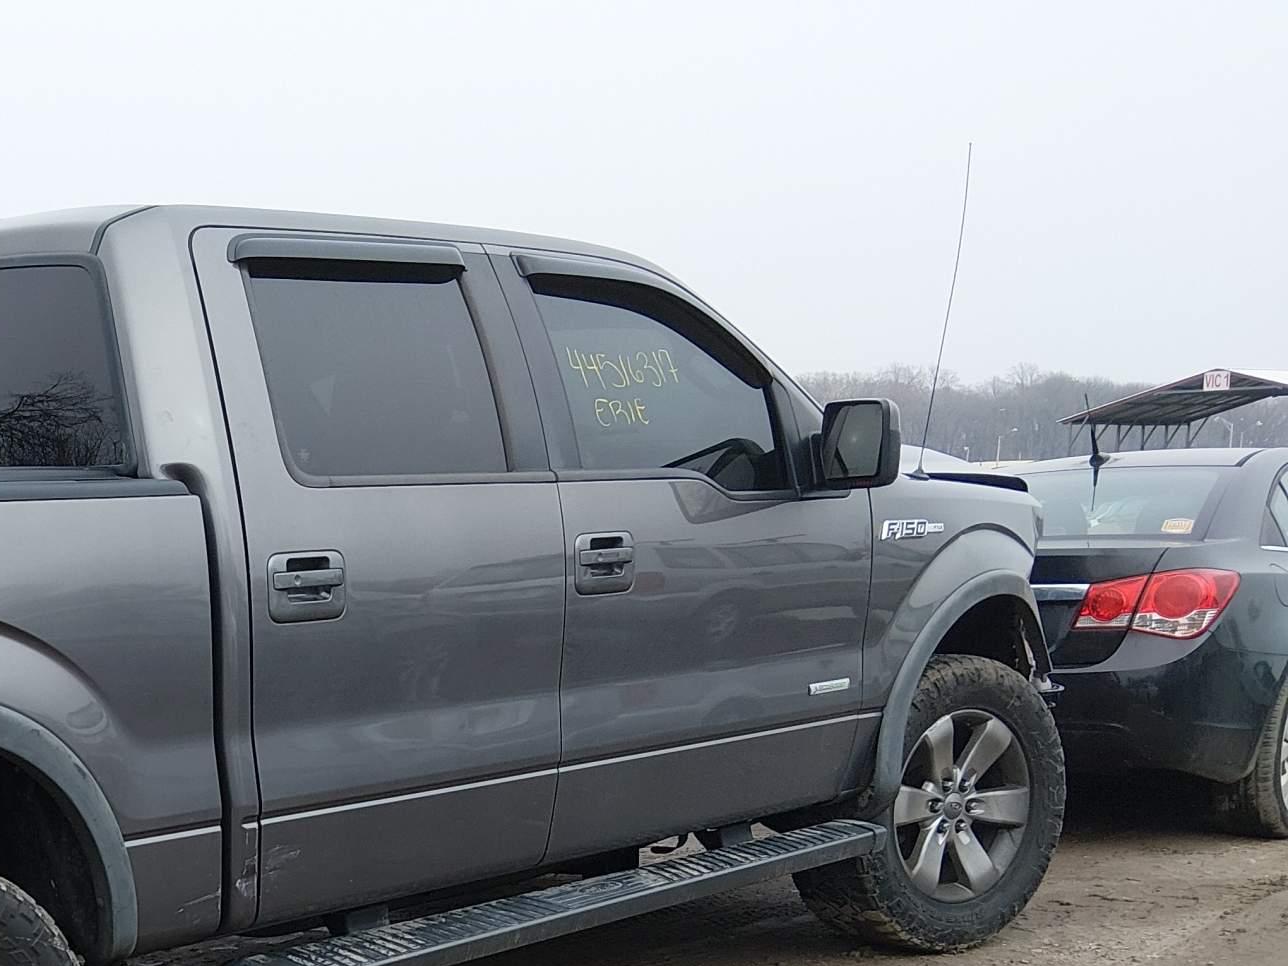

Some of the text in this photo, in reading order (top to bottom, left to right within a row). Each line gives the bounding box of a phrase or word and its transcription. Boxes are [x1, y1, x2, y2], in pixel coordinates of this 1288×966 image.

[566, 347, 679, 390] 44516317
[1205, 373, 1230, 388] VIC 1
[594, 398, 649, 427] ERIE
